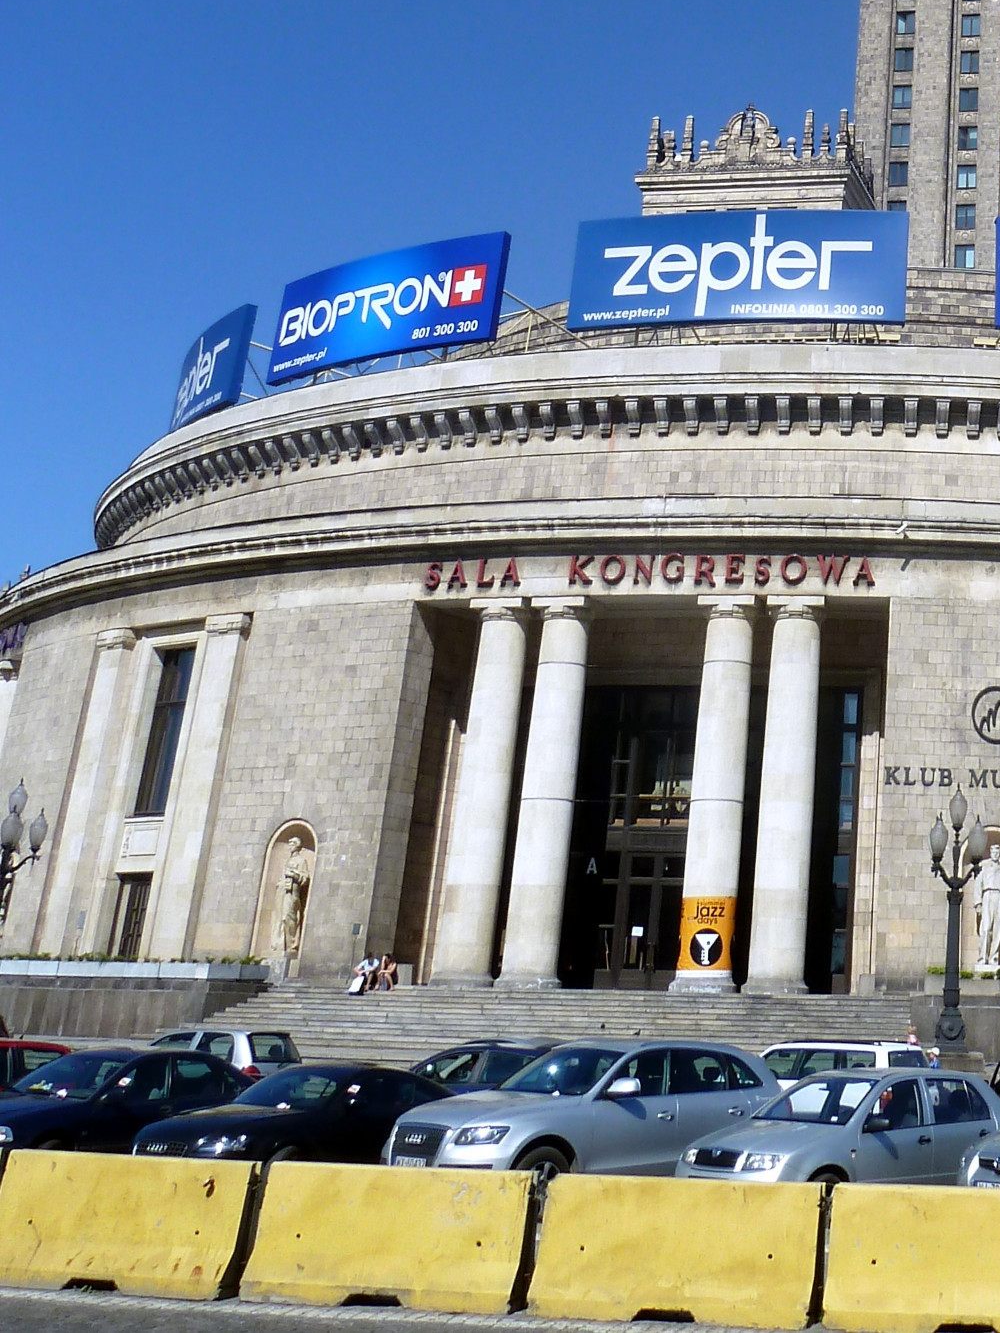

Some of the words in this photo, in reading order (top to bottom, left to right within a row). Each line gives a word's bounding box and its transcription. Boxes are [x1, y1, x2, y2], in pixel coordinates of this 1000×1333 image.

[604, 213, 873, 317] zepter
[279, 269, 454, 347] BIOPTRON
[583, 305, 670, 321] www.zepter.pl
[730, 303, 796, 315] INFOLINIA
[800, 304, 829, 315] 0801
[834, 304, 858, 315] 300
[861, 305, 885, 316] 300
[412, 326, 431, 339] 801
[433, 323, 455, 336] 300
[456, 319, 479, 333] 300
[273, 346, 328, 373] www.zepter.pl
[424, 556, 522, 589] SALA
[568, 553, 876, 588] KONGRESOWA
[884, 766, 953, 787] KLUB
[586, 857, 598, 875] A
[694, 900, 725, 920] jazz
[697, 916, 718, 926] days
